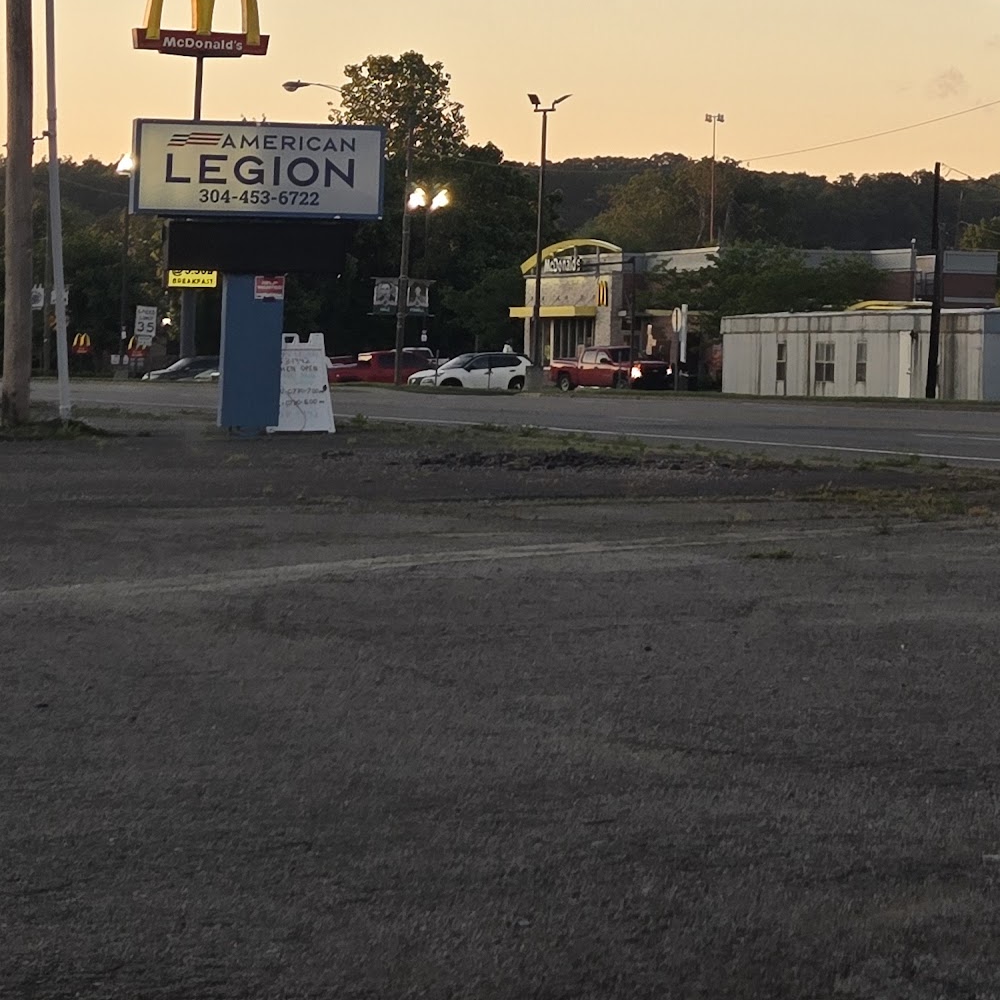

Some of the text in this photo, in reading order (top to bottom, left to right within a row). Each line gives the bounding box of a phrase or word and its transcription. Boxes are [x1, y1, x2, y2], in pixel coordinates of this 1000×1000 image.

[162, 36, 243, 51] McDonald's
[221, 133, 356, 152] AMERICAN
[165, 153, 355, 189] LEGION
[199, 189, 320, 206] 304-453-6722
[137, 321, 155, 333] 35
